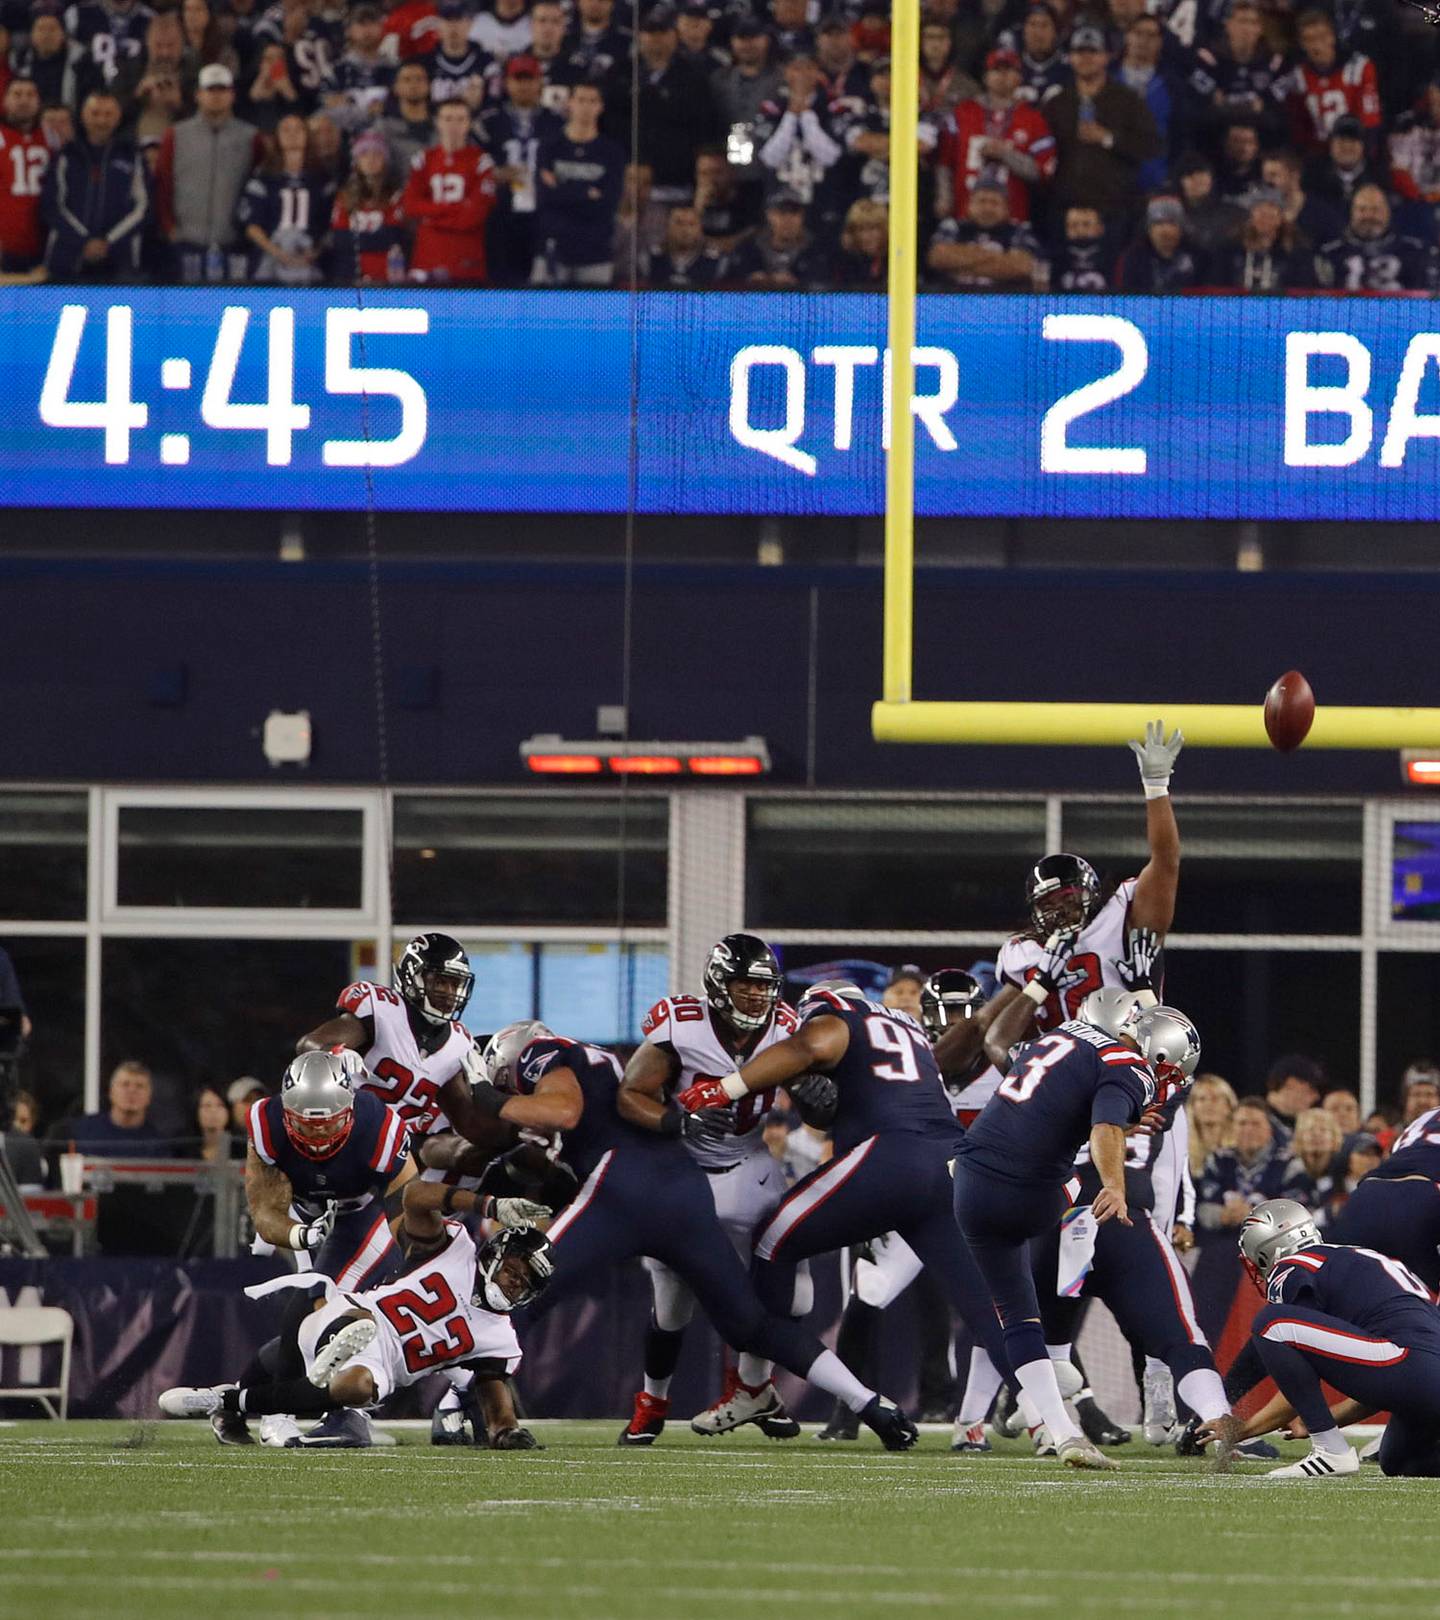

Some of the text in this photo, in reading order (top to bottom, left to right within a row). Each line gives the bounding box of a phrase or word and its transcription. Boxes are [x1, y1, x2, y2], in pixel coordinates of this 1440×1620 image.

[8, 146, 50, 197] 12
[279, 188, 311, 230] 11
[40, 305, 430, 466] 4:45
[729, 314, 1149, 475] QTR 2
[999, 1033, 1076, 1103] 3
[375, 1271, 476, 1375] 23
